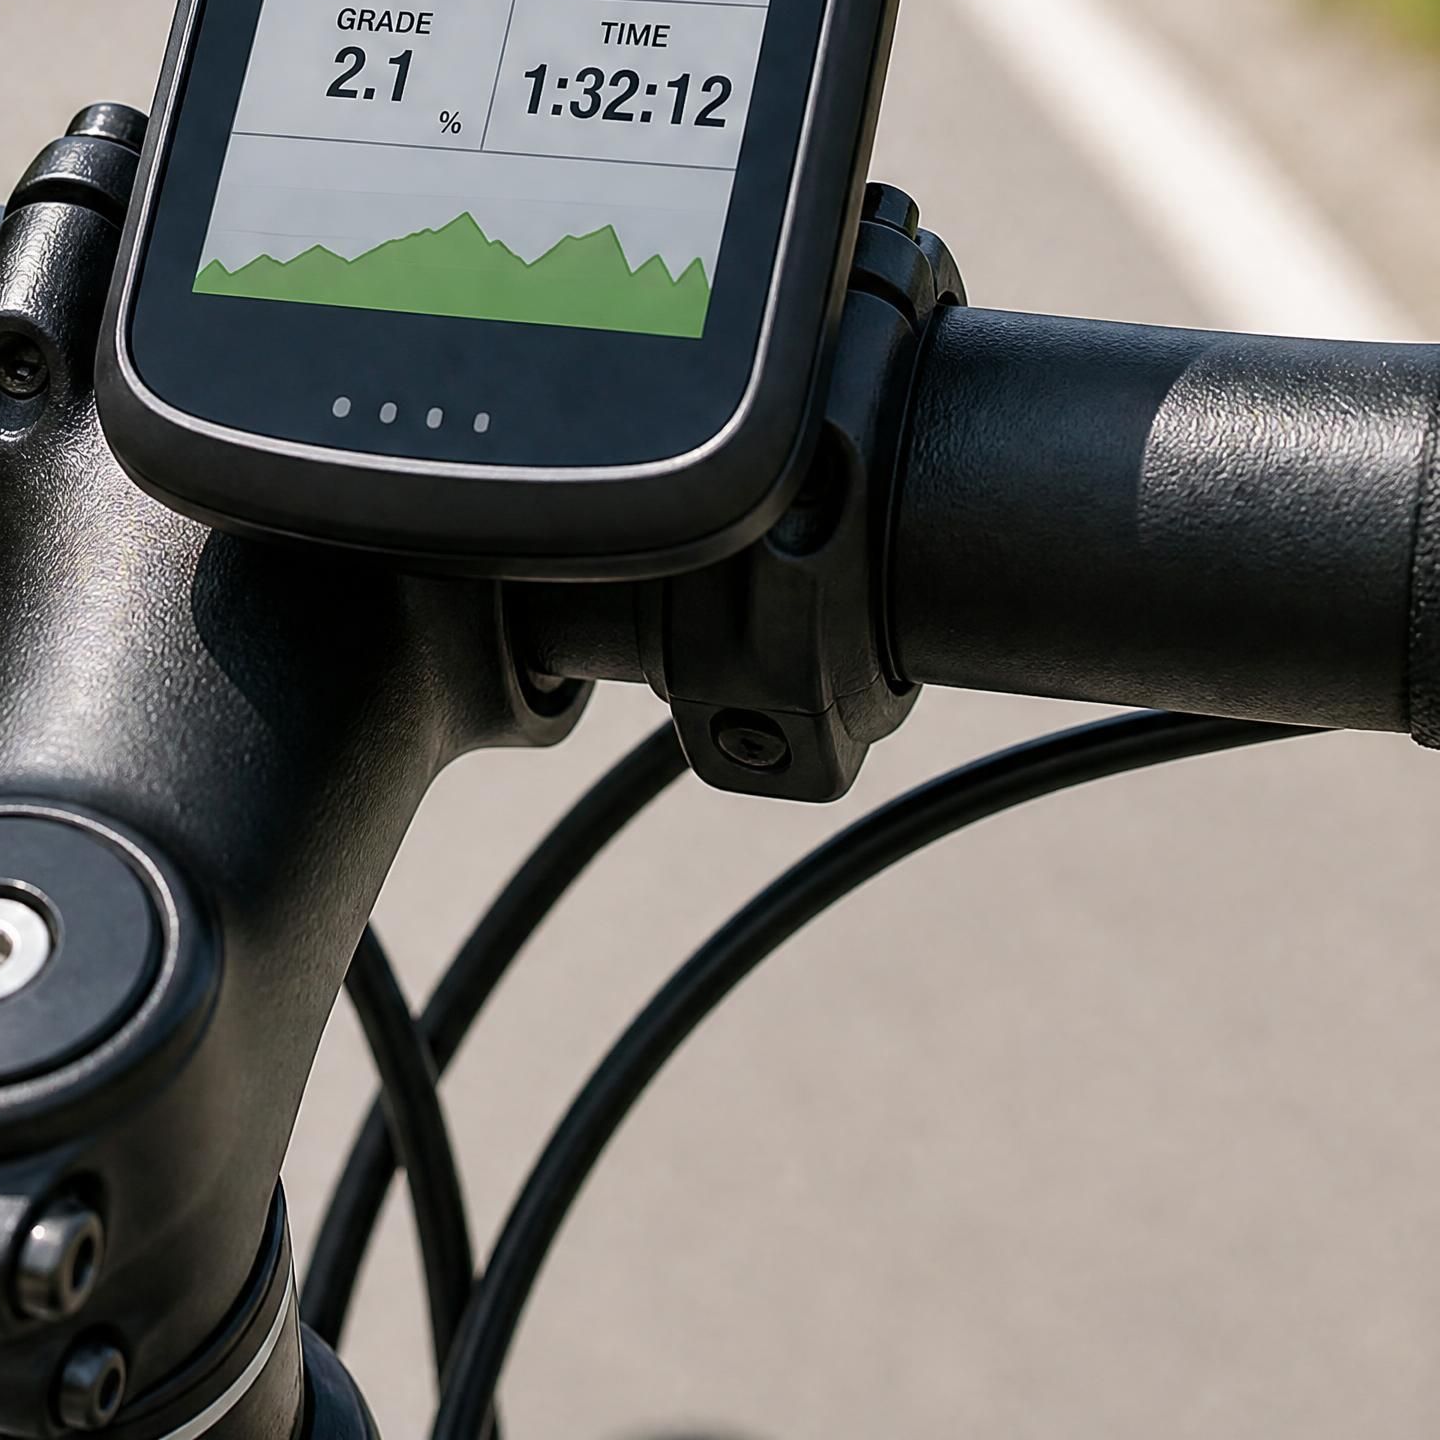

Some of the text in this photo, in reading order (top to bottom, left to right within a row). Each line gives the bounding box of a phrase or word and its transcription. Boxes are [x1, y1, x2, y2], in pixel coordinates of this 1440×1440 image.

[336, 7, 434, 34] GRADE
[600, 21, 670, 48] TIME
[326, 46, 462, 134] 2.1 %
[523, 63, 733, 128] 1:32:12
